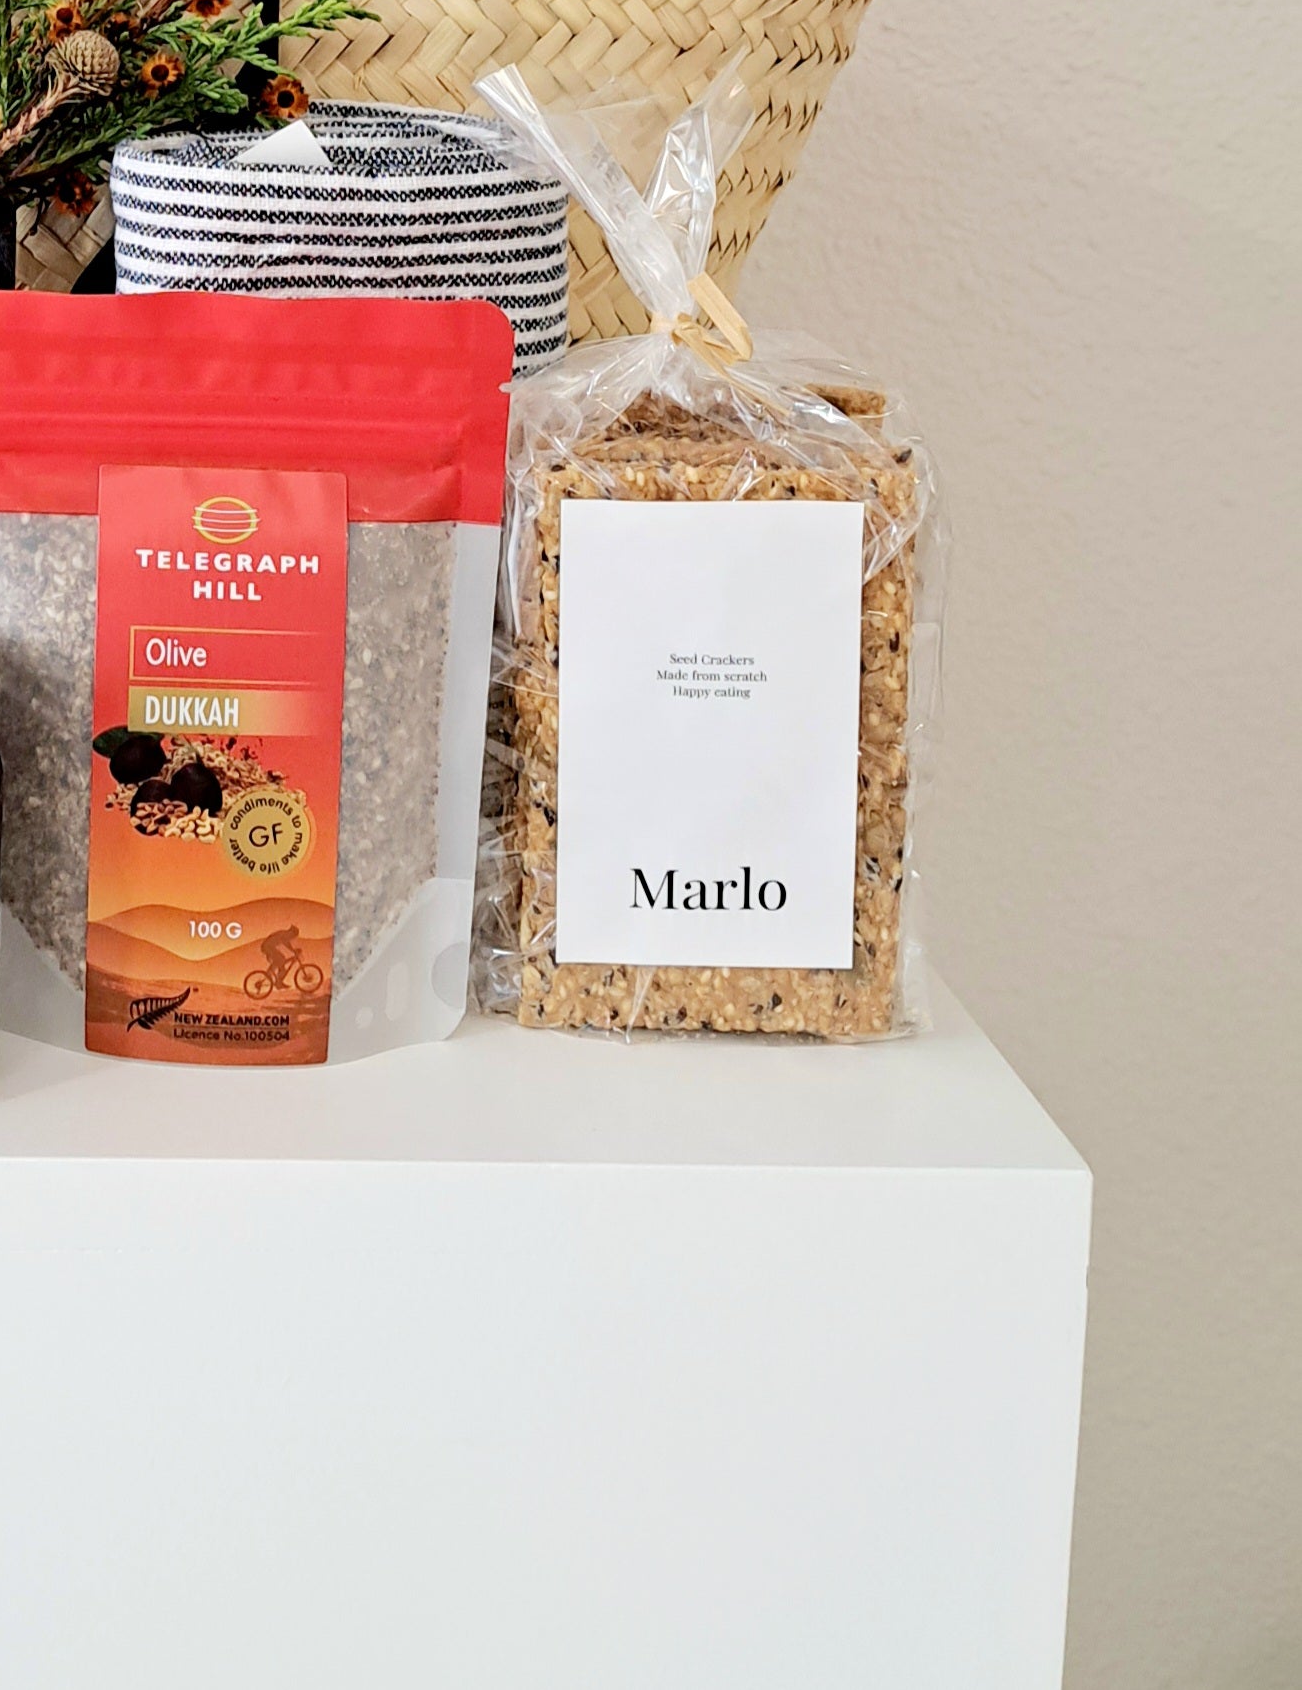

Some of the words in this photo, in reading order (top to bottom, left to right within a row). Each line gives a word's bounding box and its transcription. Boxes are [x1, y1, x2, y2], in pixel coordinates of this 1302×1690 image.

[135, 549, 319, 575] TELEGRAPH
[193, 580, 262, 601] HILL
[145, 638, 207, 667] Olive
[669, 653, 698, 665] Seed
[701, 654, 755, 666] Crackers
[656, 669, 689, 681] Made
[692, 670, 721, 682] from
[724, 671, 768, 682] scratch
[673, 685, 712, 700] Happy
[714, 686, 752, 700] eating
[144, 695, 239, 728] DUKKAH
[230, 797, 294, 830] condiments
[291, 815, 302, 829] to
[248, 822, 283, 848] GF
[229, 838, 256, 872] better
[281, 832, 303, 865] make
[260, 861, 280, 875] life
[630, 867, 787, 911] Marlo
[188, 920, 222, 939] 100
[225, 921, 242, 940] G
[174, 1014, 203, 1025] NEW
[205, 1014, 290, 1026] ZEALAND.COM
[173, 1028, 220, 1040] Licence
